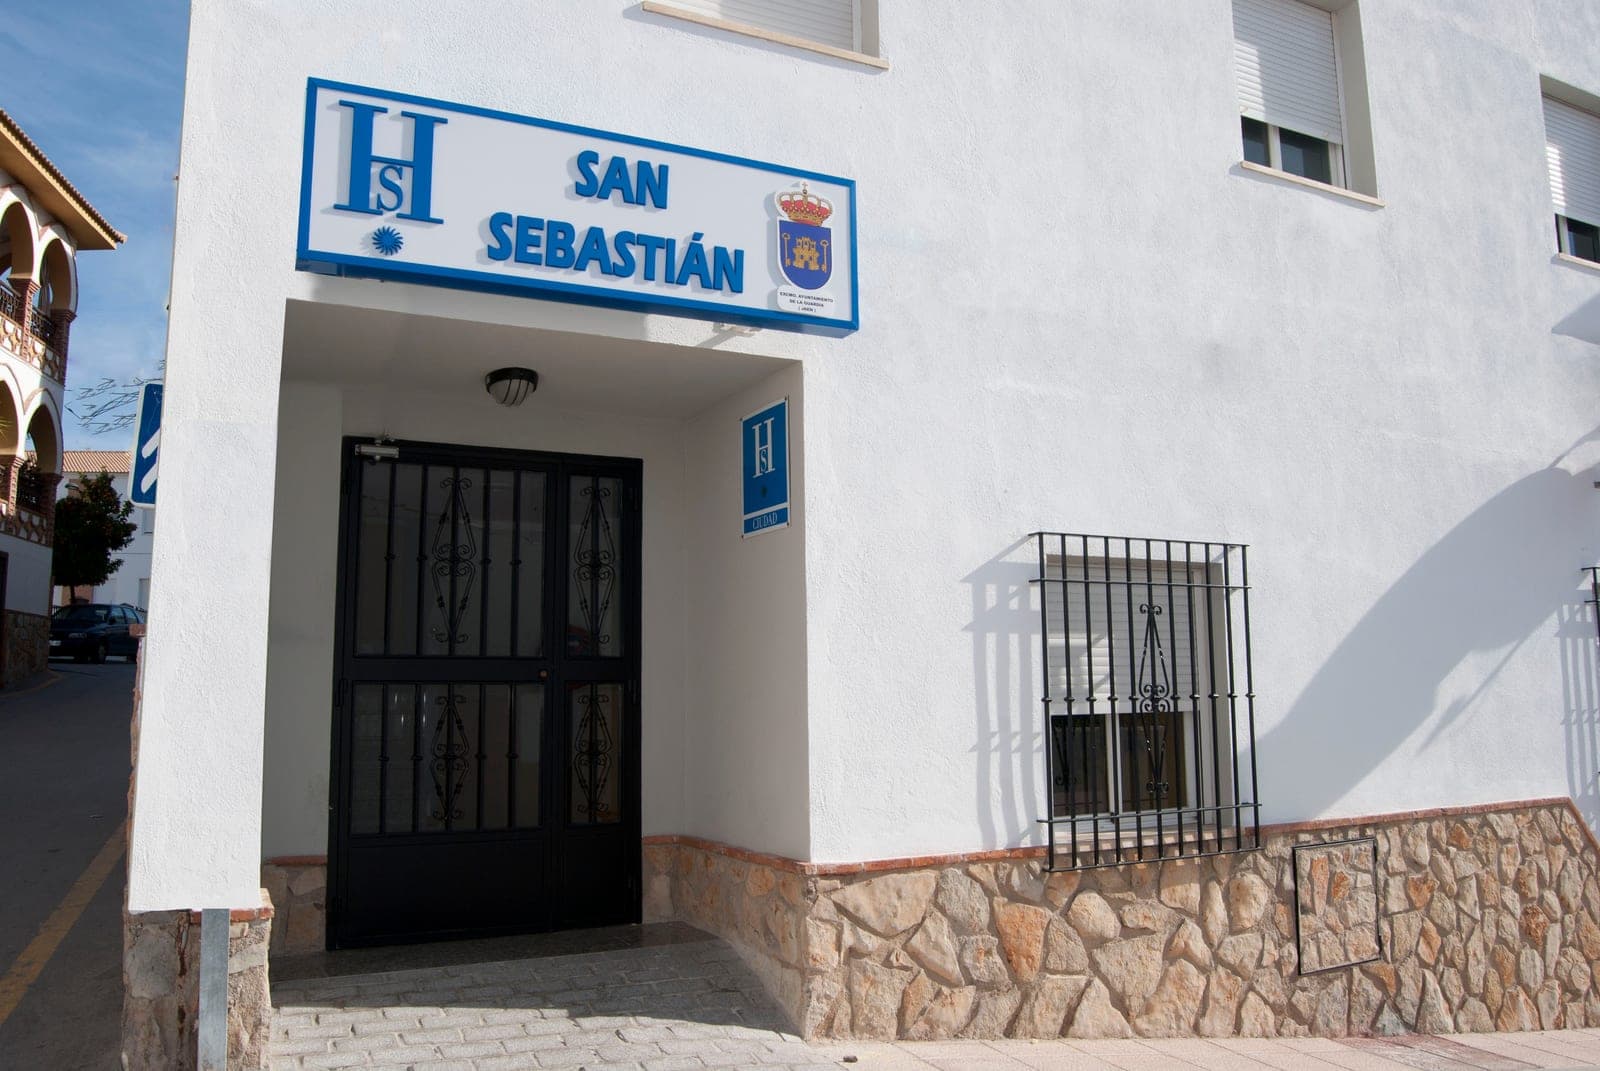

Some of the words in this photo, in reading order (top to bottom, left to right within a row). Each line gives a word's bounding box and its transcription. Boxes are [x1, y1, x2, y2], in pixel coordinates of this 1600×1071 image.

[575, 150, 669, 209] SAN
[487, 212, 744, 293] SEBASTIÁN
[798, 294, 834, 302] AYUNTAMIENTO
[752, 512, 778, 530] CIUDAD
